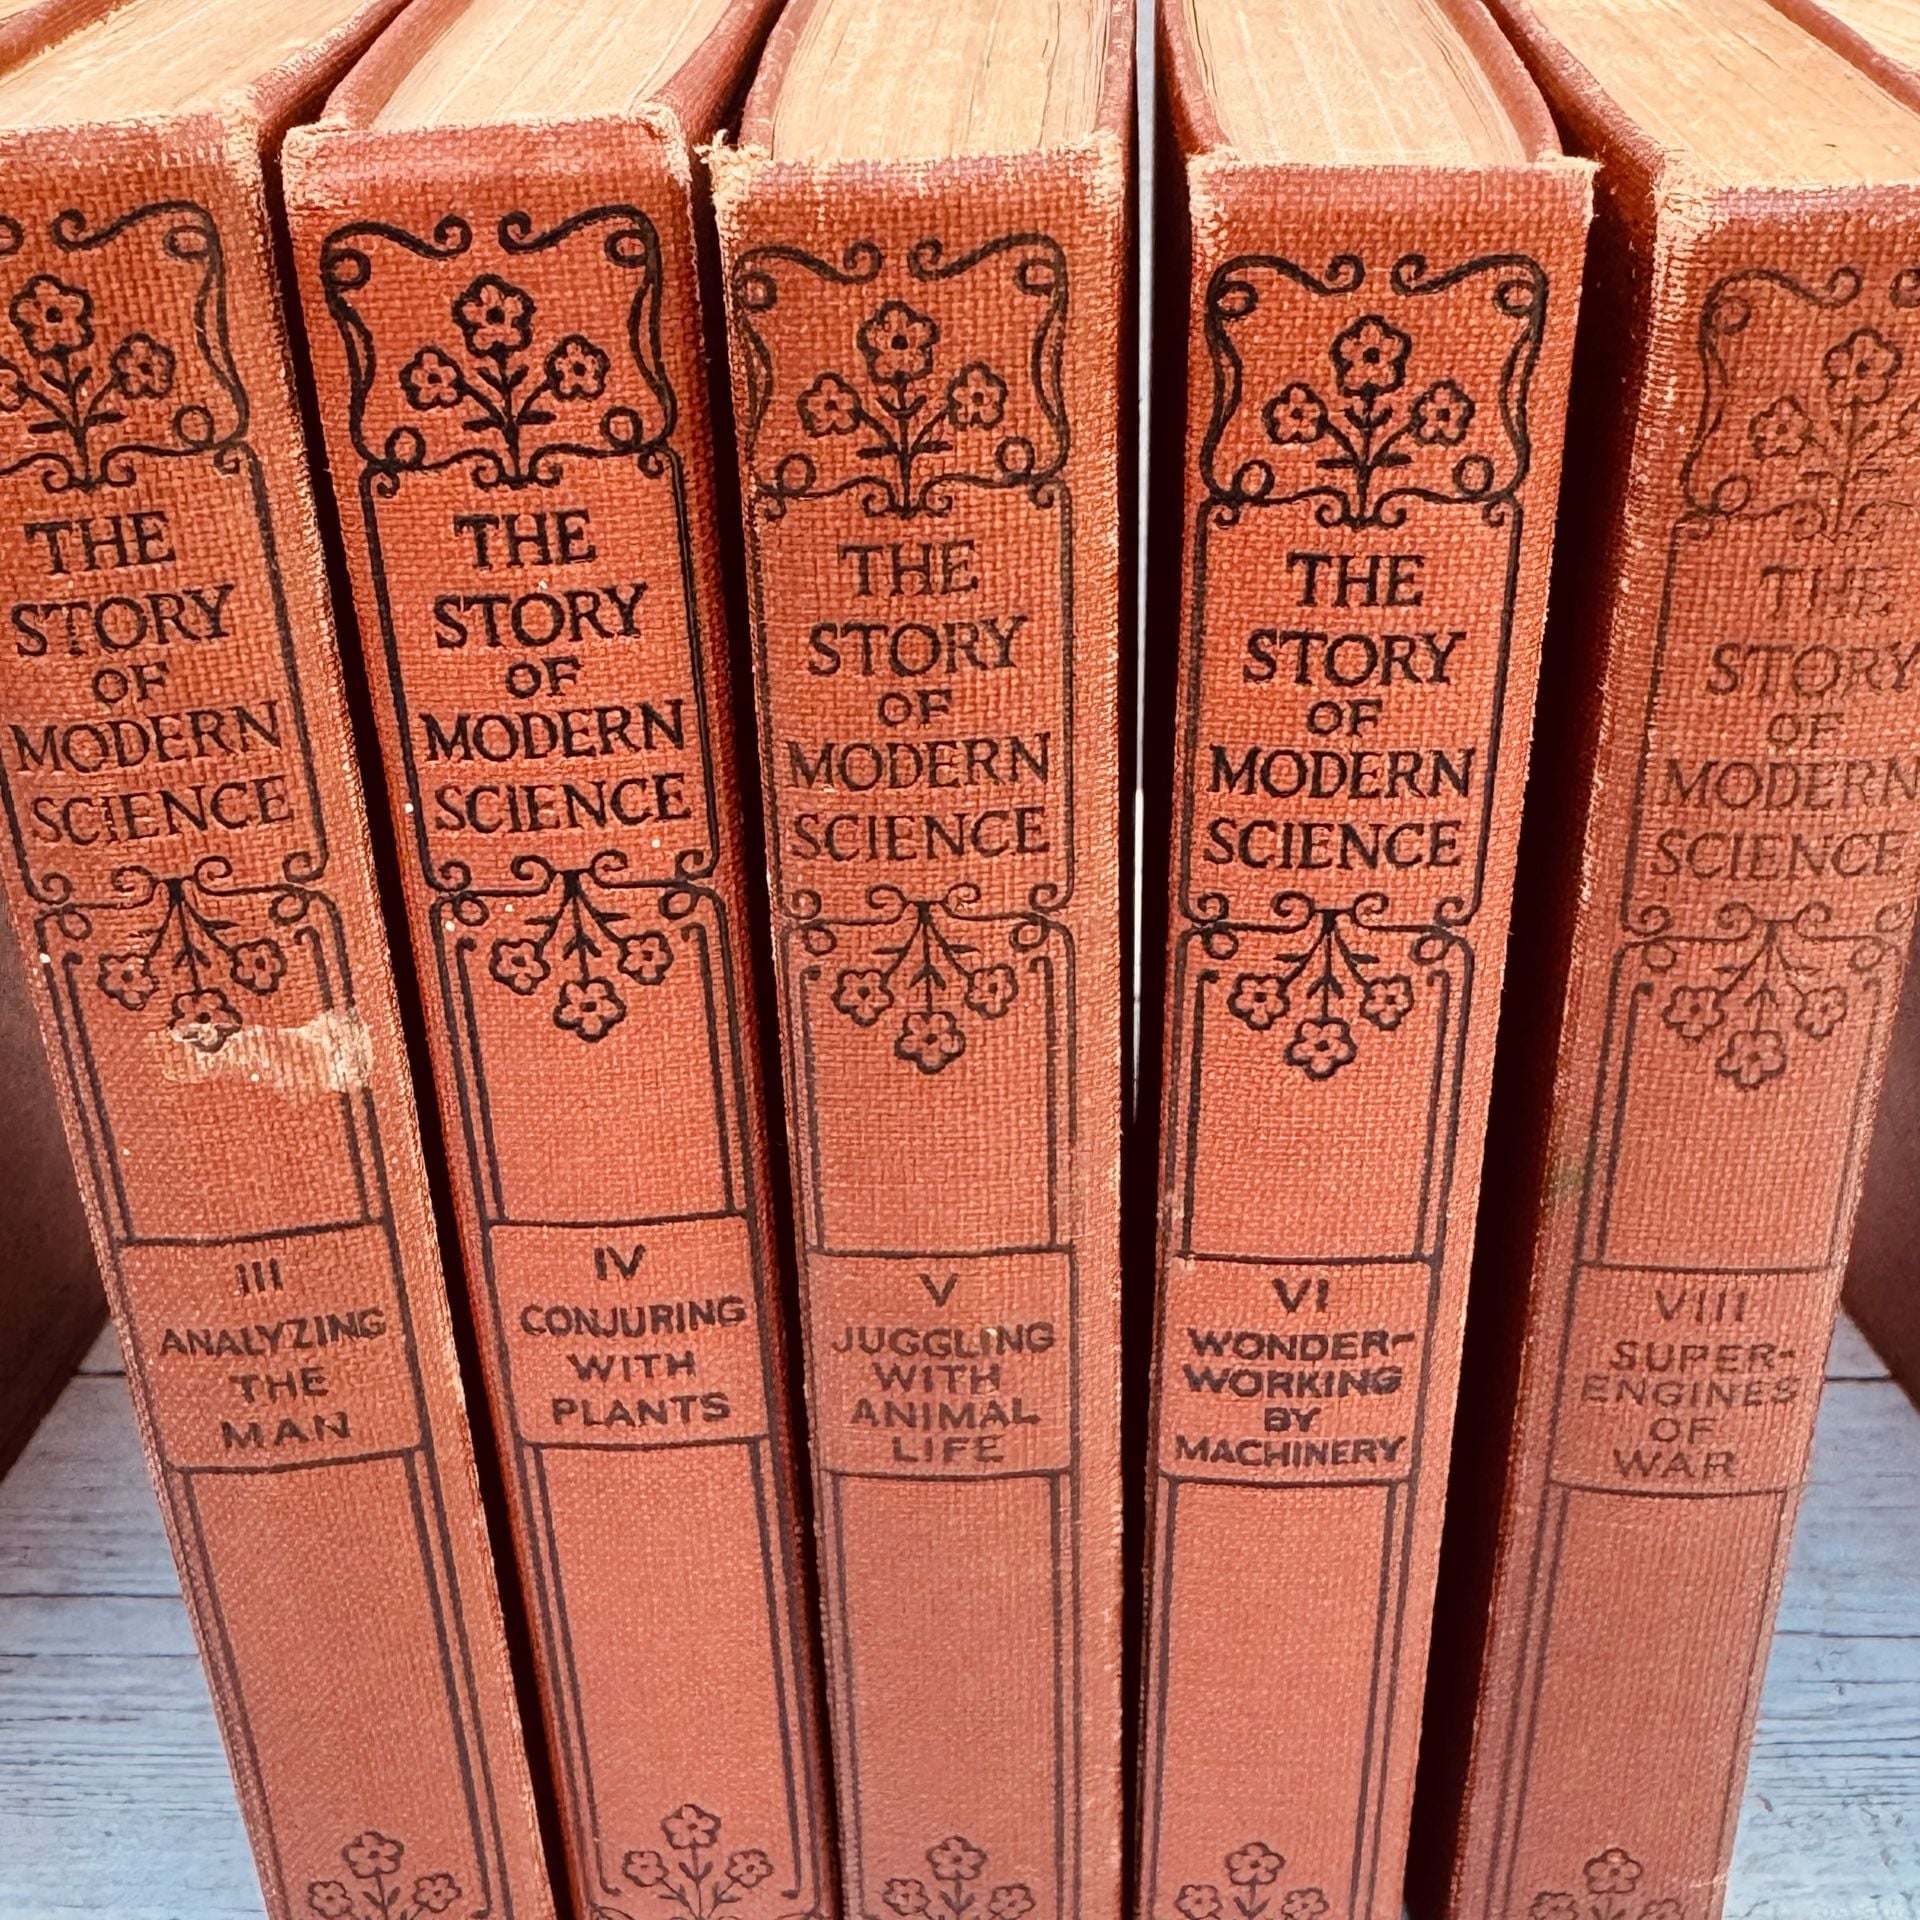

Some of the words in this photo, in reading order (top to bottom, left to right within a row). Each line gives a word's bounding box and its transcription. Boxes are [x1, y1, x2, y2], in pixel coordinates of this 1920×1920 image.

[24, 511, 176, 574] THE
[454, 509, 596, 570] THE
[837, 540, 978, 596] THE
[1286, 551, 1425, 607] THE
[1761, 565, 1896, 619] THE
[11, 584, 234, 657] STORY
[433, 582, 647, 648] STORY
[808, 615, 1027, 677] STORY
[1243, 628, 1467, 686] STORY
[92, 661, 170, 704] OF
[505, 655, 584, 698] OF
[1706, 640, 1920, 698] STORY
[877, 689, 952, 728] OF
[1306, 699, 1383, 737] OF
[10, 700, 282, 773] MODERN
[419, 699, 686, 762] MODERN
[1767, 711, 1844, 750] OF
[786, 731, 1050, 791] MODERN
[1207, 744, 1475, 799] MODERN
[434, 772, 692, 833] SCIENCE
[1658, 758, 1920, 811] MODERN
[32, 775, 295, 845] SCIENCE
[791, 806, 1050, 862] SCIENCE
[1203, 817, 1462, 870] SCIENCE
[1653, 827, 1910, 880] SCIENCE
[236, 1258, 283, 1296] III
[594, 1244, 645, 1280] IV
[919, 1273, 959, 1307] V
[1272, 1278, 1329, 1313] VI
[1655, 1289, 1746, 1322] VIII
[159, 1307, 387, 1357] ANALYZING
[520, 1295, 746, 1338] CONJURING
[832, 1322, 1056, 1358] JUGGLING
[1187, 1328, 1415, 1361] WONDER-
[1610, 1340, 1796, 1373] SUPER-
[229, 1367, 329, 1403] THE
[566, 1351, 696, 1382] WITH
[873, 1362, 1001, 1394] WITH
[1183, 1364, 1402, 1398] WORKING
[552, 1392, 730, 1427] PLANTS
[1581, 1374, 1800, 1407] ENGINES
[220, 1411, 350, 1448] MAN
[850, 1398, 1041, 1430] ANIMAL
[1264, 1406, 1322, 1432] BY
[1649, 1417, 1717, 1444] OF
[892, 1434, 1005, 1463] LIFE
[1176, 1435, 1407, 1467] MACHINERY
[1613, 1449, 1735, 1478] WAR
